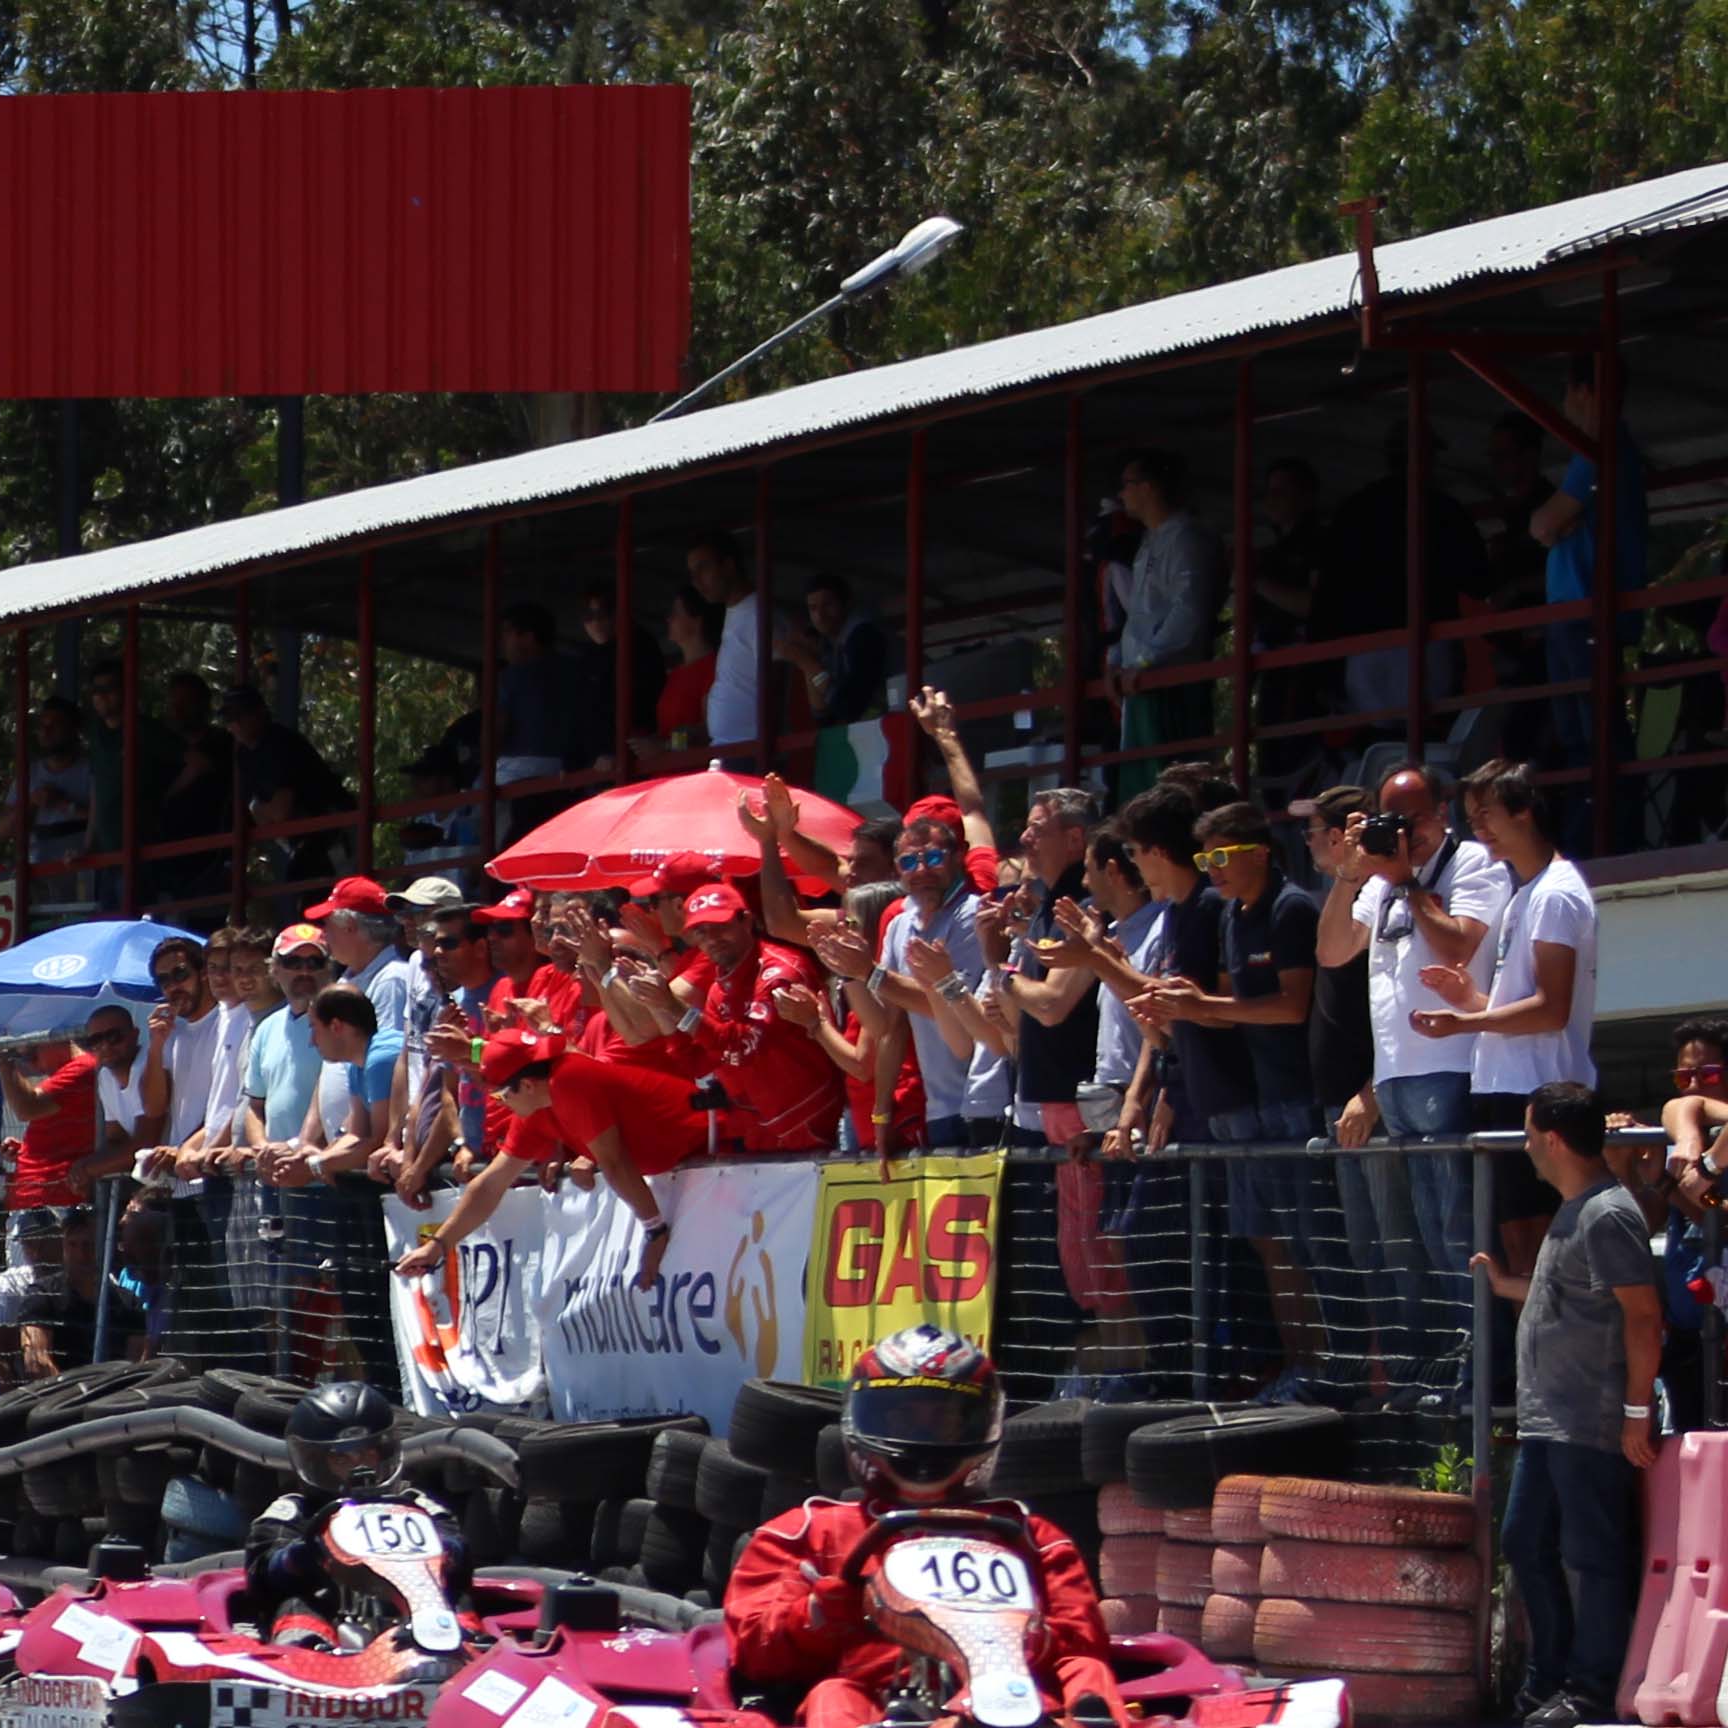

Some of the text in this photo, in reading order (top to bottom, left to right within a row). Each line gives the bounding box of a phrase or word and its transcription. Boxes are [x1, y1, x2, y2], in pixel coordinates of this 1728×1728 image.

[823, 1194, 992, 1307] GAS
[556, 1250, 722, 1355] multicare
[354, 1513, 426, 1548] 150
[919, 1551, 1019, 1598] 160
[285, 1689, 427, 1719] INDOOR
